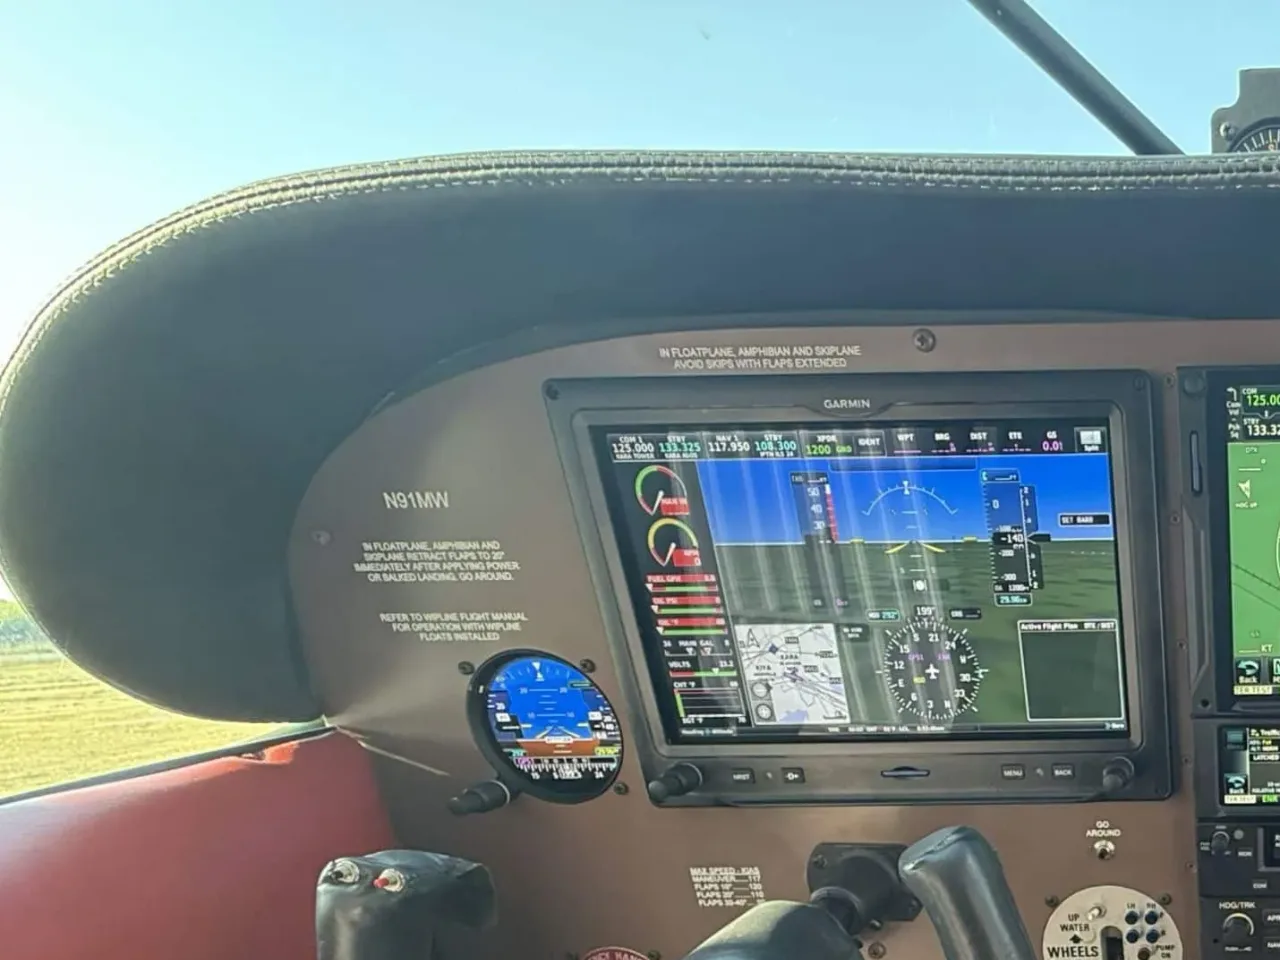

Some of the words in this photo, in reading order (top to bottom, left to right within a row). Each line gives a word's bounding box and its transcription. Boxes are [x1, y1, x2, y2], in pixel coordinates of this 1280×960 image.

[659, 348, 670, 358] IN
[738, 346, 791, 357] AMPHIBIAN
[792, 346, 814, 356] AND
[815, 345, 862, 356] SKIPLANE
[674, 359, 704, 370] AVOID
[706, 359, 735, 369] SKIPS
[735, 358, 762, 369] WITH
[763, 358, 794, 368] FLAPS
[795, 357, 847, 368] EXTENDED
[823, 398, 871, 409] GARMIN
[667, 435, 686, 443] STBY
[897, 433, 915, 441] WPT
[970, 432, 987, 440] DIST
[754, 441, 797, 451] 108.300
[858, 438, 880, 446] IDENT
[612, 443, 655, 453] 125.000
[659, 442, 701, 453] 133.325
[708, 442, 750, 452] 117.950
[807, 487, 819, 498] 50
[383, 491, 449, 509] N91MW
[811, 504, 823, 514] 40
[813, 521, 825, 530] 30
[482, 540, 501, 550] AND
[406, 552, 447, 561] RETRACT
[449, 552, 477, 561] FLAPS
[477, 551, 490, 560] TO
[354, 562, 411, 572] IMMEDIATELY
[413, 562, 441, 571] AFTER
[442, 561, 485, 571] APPLYING
[368, 573, 382, 582] OR
[383, 572, 417, 581] BALKED
[459, 572, 473, 581] GO
[380, 613, 411, 622] REFER
[411, 612, 423, 621] TO
[424, 612, 459, 621] WIPLINE
[460, 612, 491, 621] FLIGHT
[491, 612, 529, 621] MANUAL
[392, 623, 411, 632] FOR
[411, 623, 461, 631] OPERATION
[462, 622, 484, 631] WITH
[485, 622, 522, 631] WIPLINE
[420, 633, 453, 641] FLOATS
[453, 632, 500, 641] INSTALLED
[928, 633, 939, 642] 21
[945, 641, 956, 650] 24
[894, 660, 905, 670] 12
[959, 673, 971, 682] 30
[1238, 675, 1258, 683] Back
[1260, 729, 1280, 737] Traffic
[1003, 769, 1022, 777] MENU
[1054, 768, 1072, 776] BACK
[1095, 820, 1110, 829] GO
[1086, 828, 1121, 837] AROUND
[708, 867, 735, 875] SPEED
[1219, 901, 1256, 910] HDG/TRK
[1068, 913, 1080, 922] UP
[1060, 923, 1090, 932] WATER
[1047, 946, 1099, 958] WHEELS
